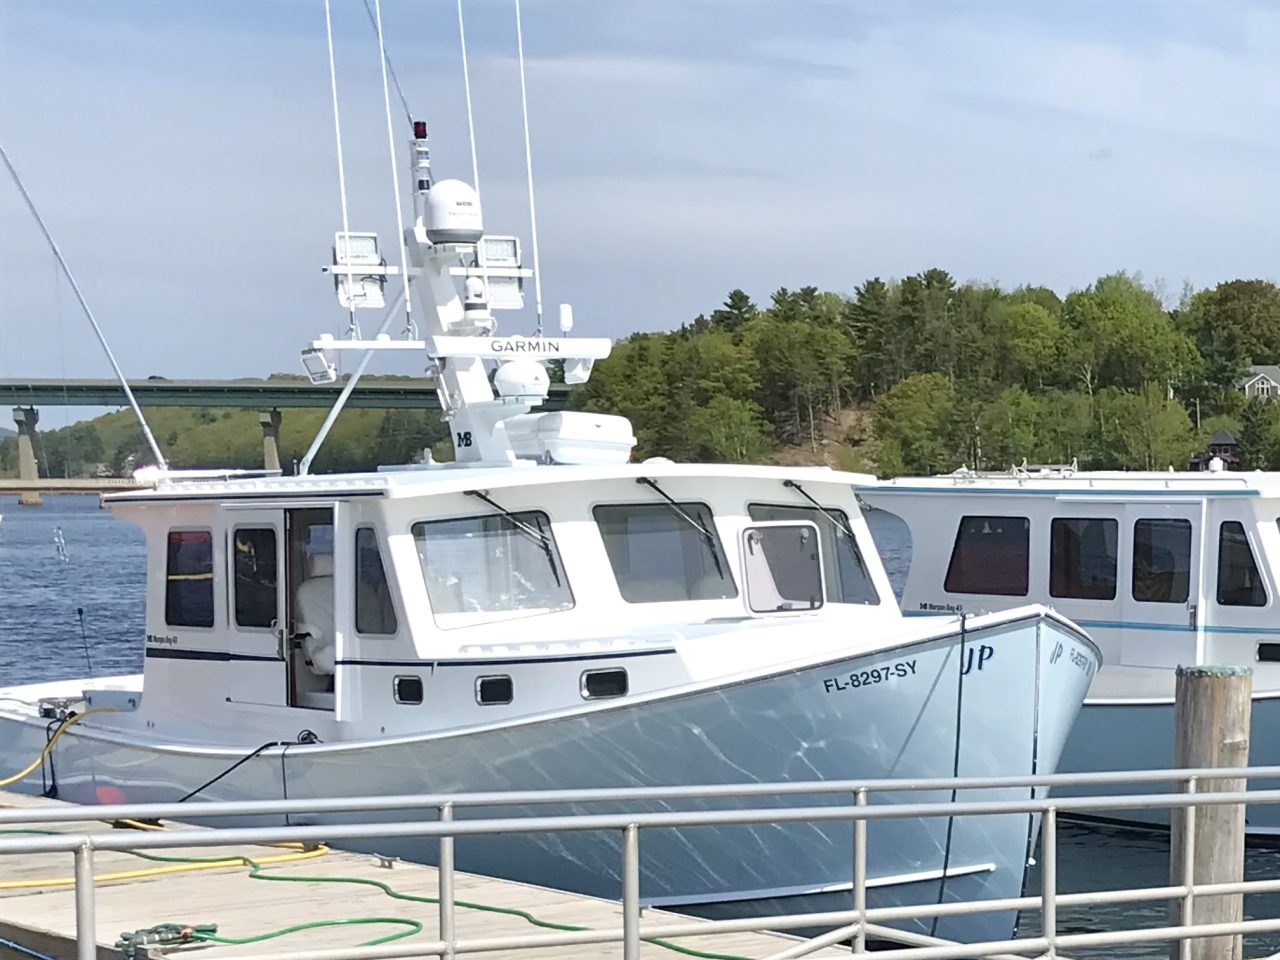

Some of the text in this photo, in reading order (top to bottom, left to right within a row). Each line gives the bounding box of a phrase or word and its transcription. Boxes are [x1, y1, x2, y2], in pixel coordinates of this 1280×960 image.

[491, 340, 560, 353] GARMIN
[822, 659, 918, 693] FL-8297-SY
[961, 644, 994, 676] JP
